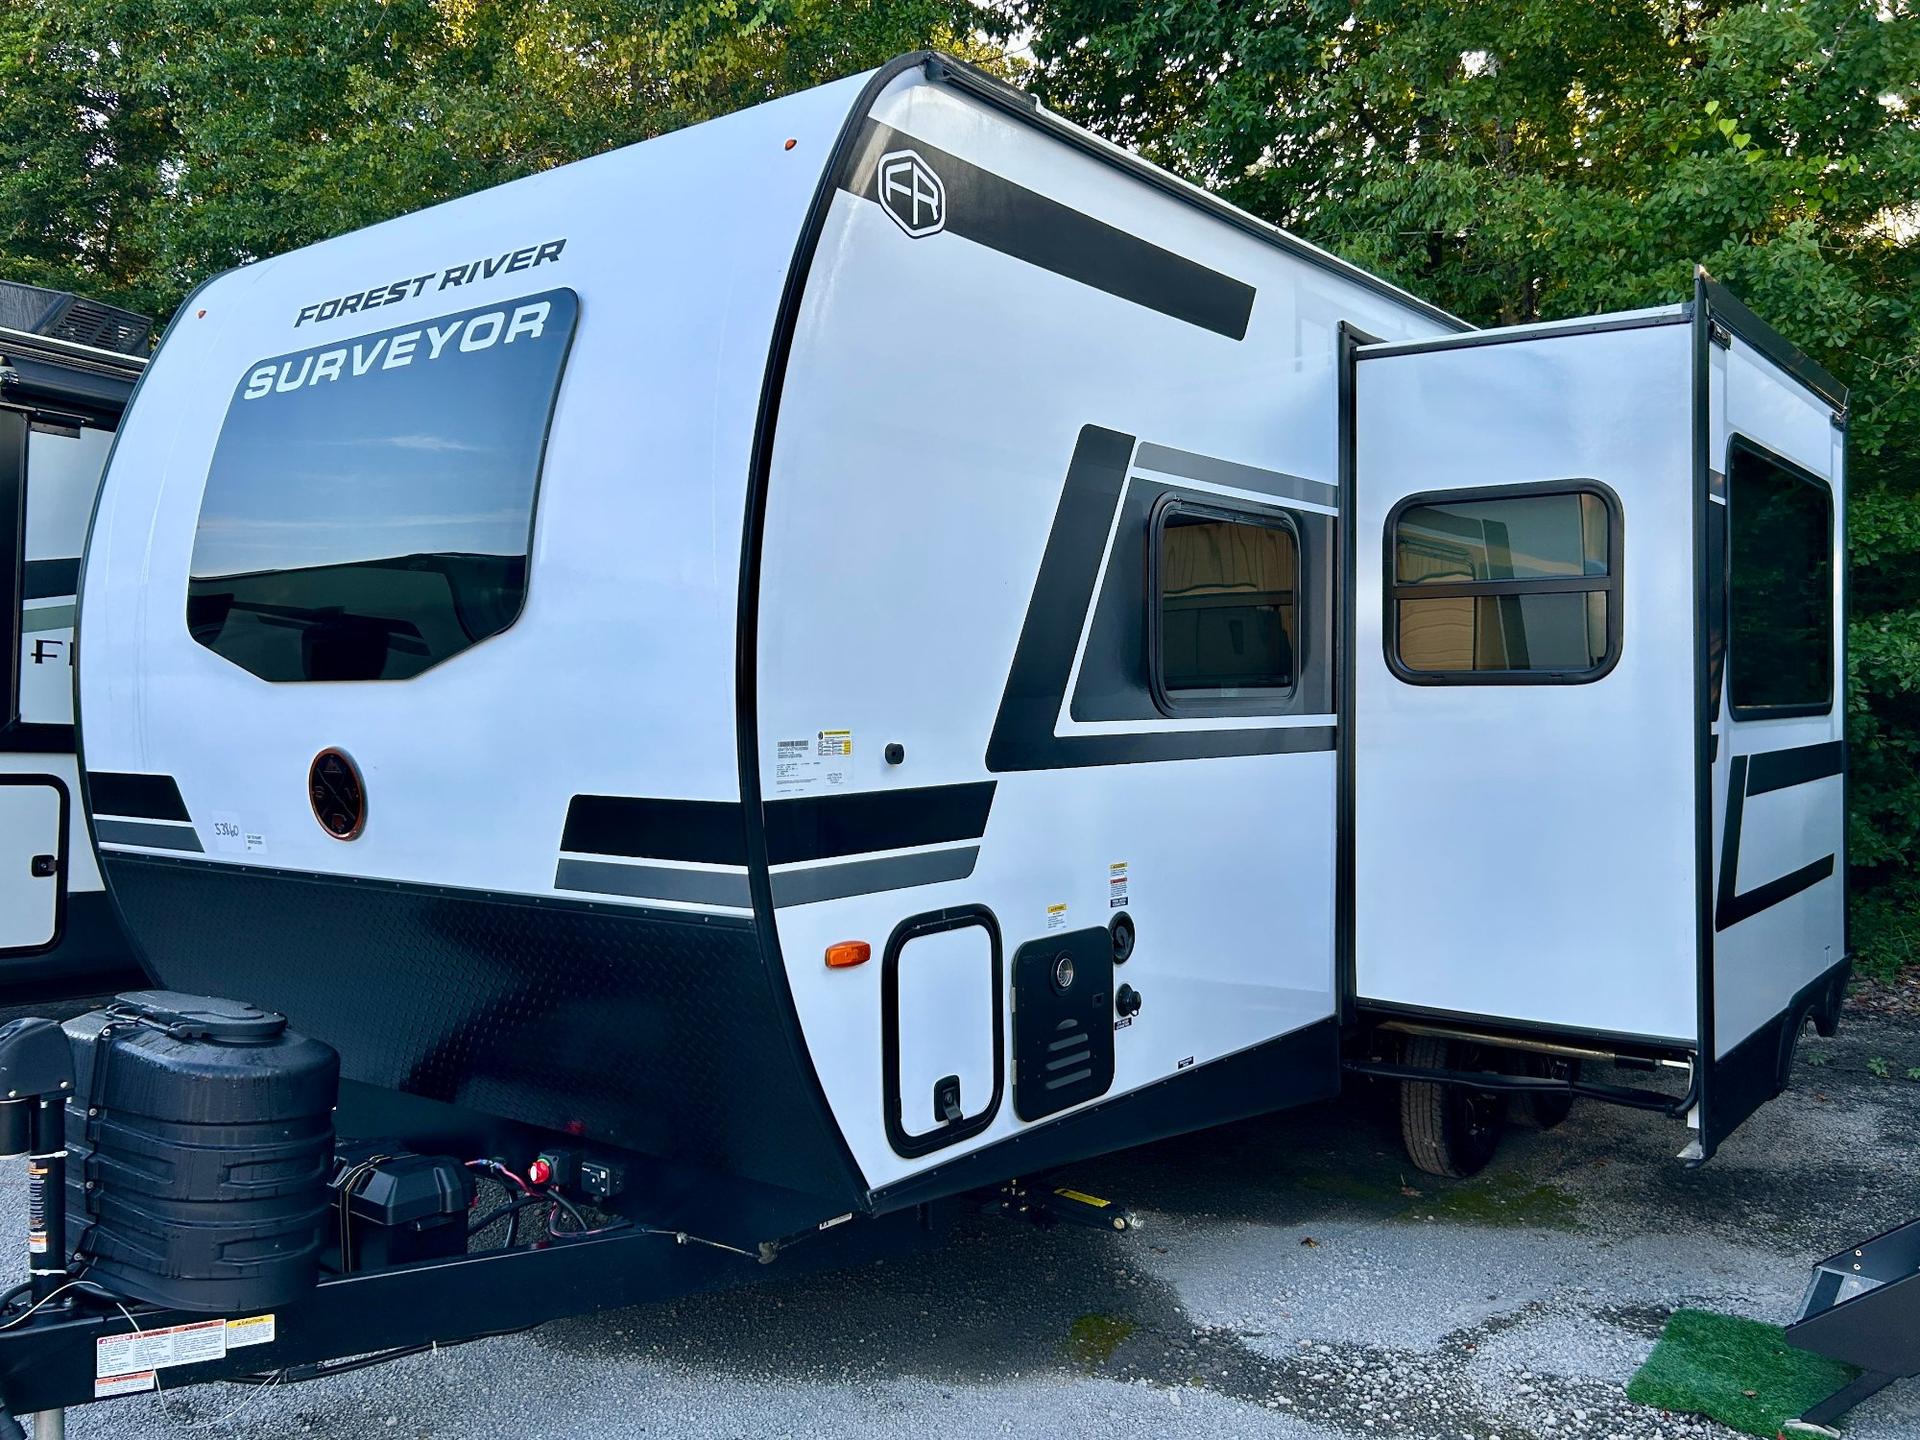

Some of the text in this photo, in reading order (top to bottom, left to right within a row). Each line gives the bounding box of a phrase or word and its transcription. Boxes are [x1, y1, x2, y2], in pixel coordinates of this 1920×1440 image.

[294, 239, 567, 328] FOREST RIVER
[244, 301, 551, 400] SURVEYOR
